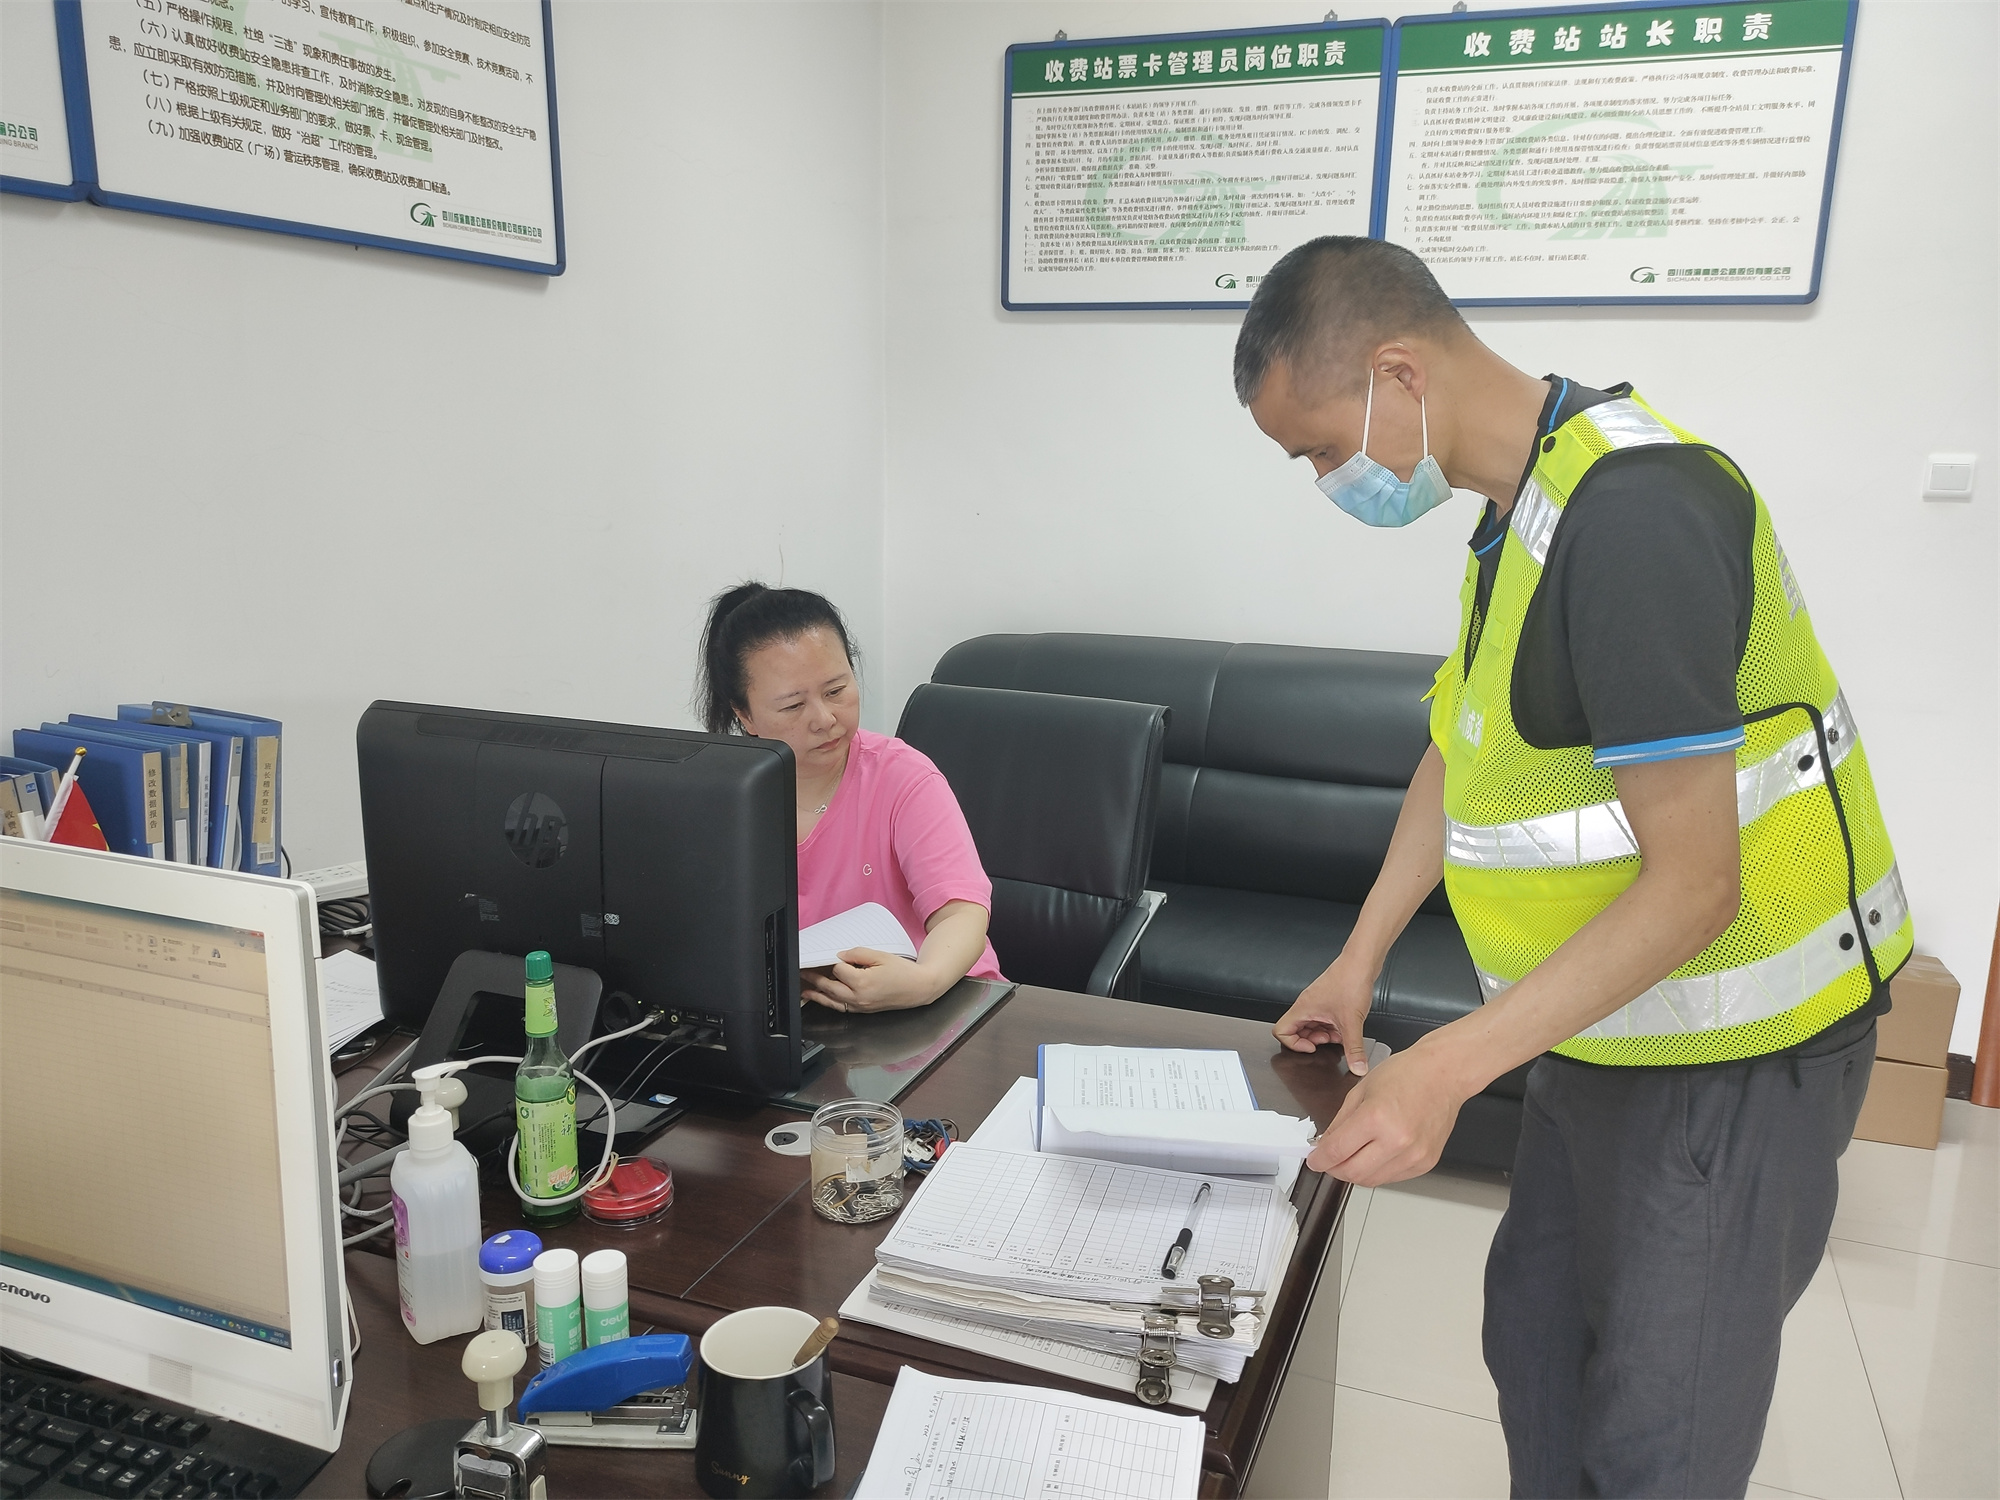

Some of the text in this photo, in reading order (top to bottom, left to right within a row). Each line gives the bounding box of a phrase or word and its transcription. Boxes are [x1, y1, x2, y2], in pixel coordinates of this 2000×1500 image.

[1463, 12, 1773, 59] 收费站站长职责
[1044, 40, 1347, 84] 收费站票卡管理员岗位职责
[862, 863, 873, 876] G
